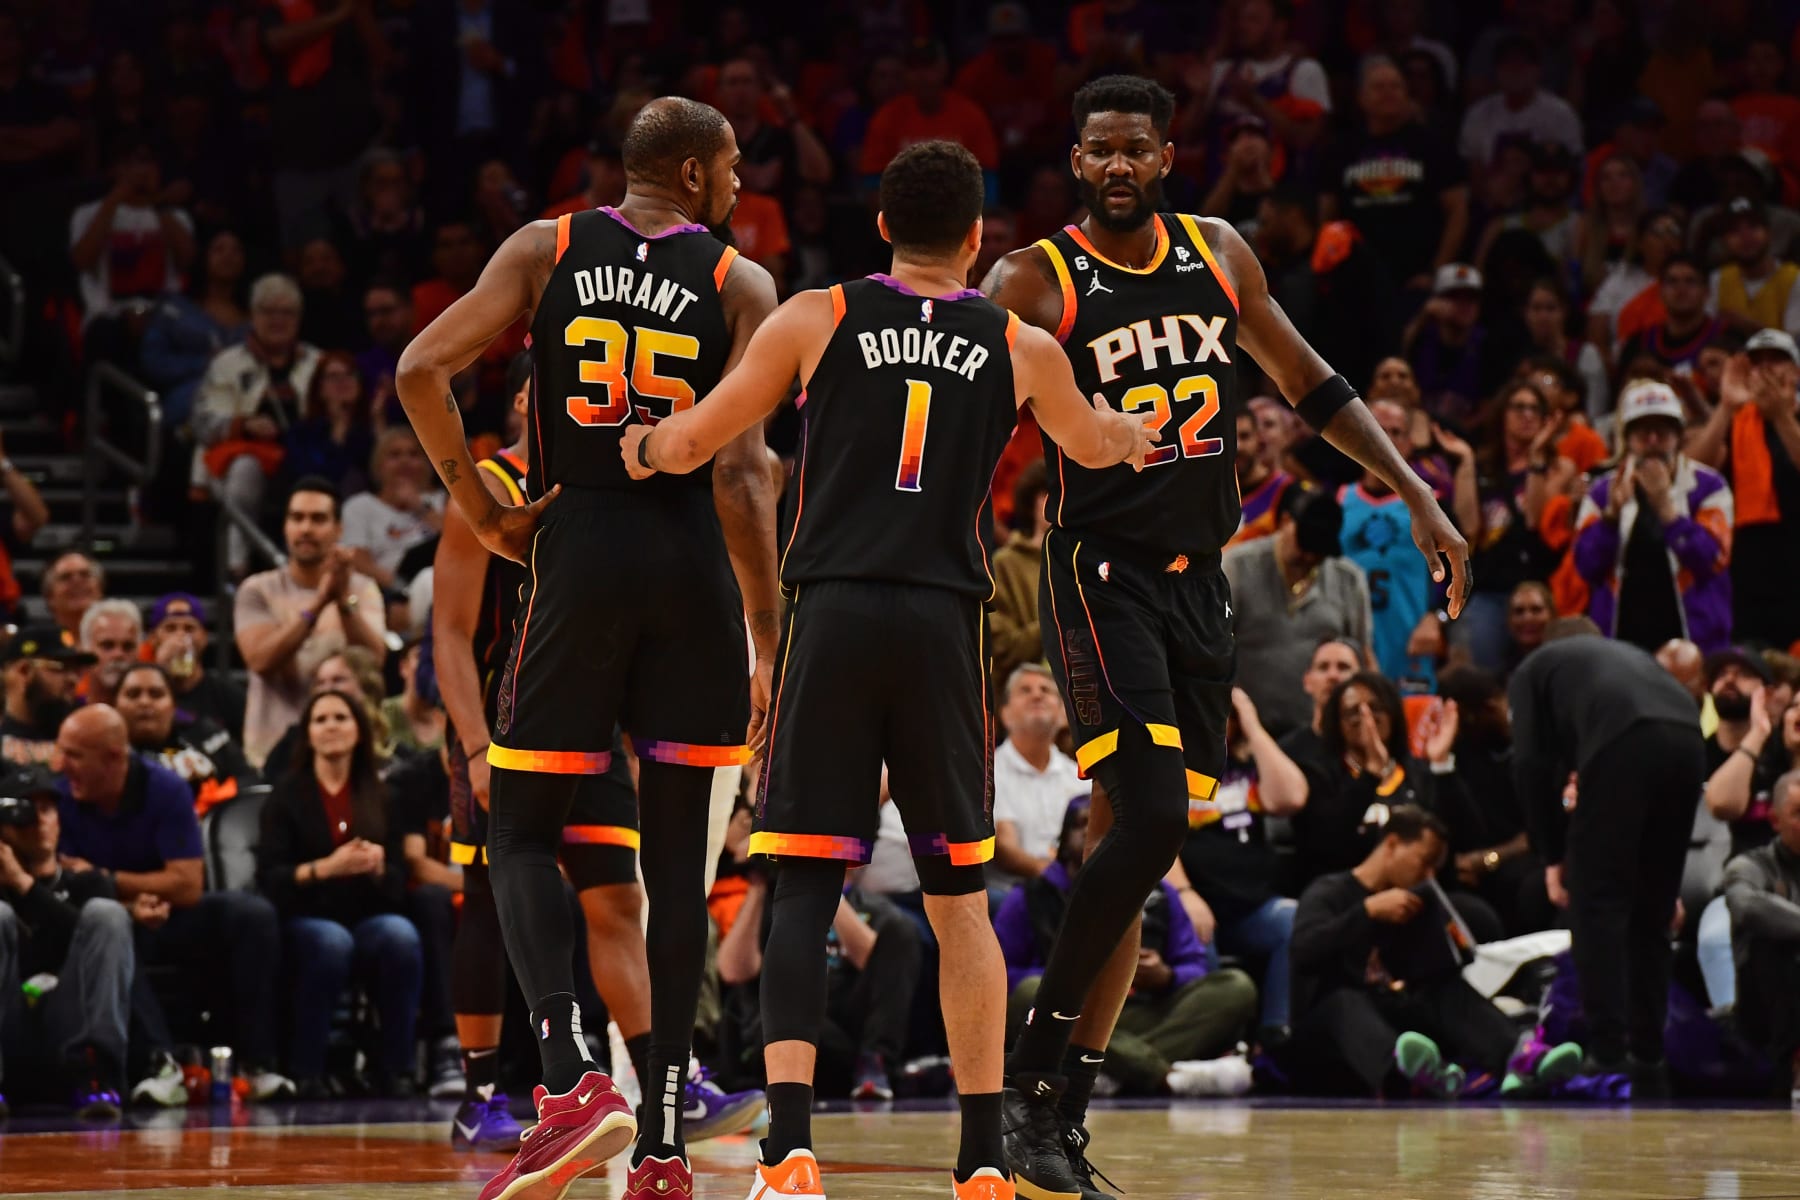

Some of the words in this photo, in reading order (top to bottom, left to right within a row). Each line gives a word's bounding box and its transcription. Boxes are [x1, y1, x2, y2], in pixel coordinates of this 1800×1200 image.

[574, 265, 699, 322] DURANT
[1074, 255, 1090, 271] 6
[1175, 261, 1205, 273] PayPal
[565, 316, 700, 428] 35
[857, 328, 989, 383] BOOKER
[1086, 314, 1231, 383] PHX
[894, 379, 932, 493] 1
[1121, 373, 1224, 468] 22
